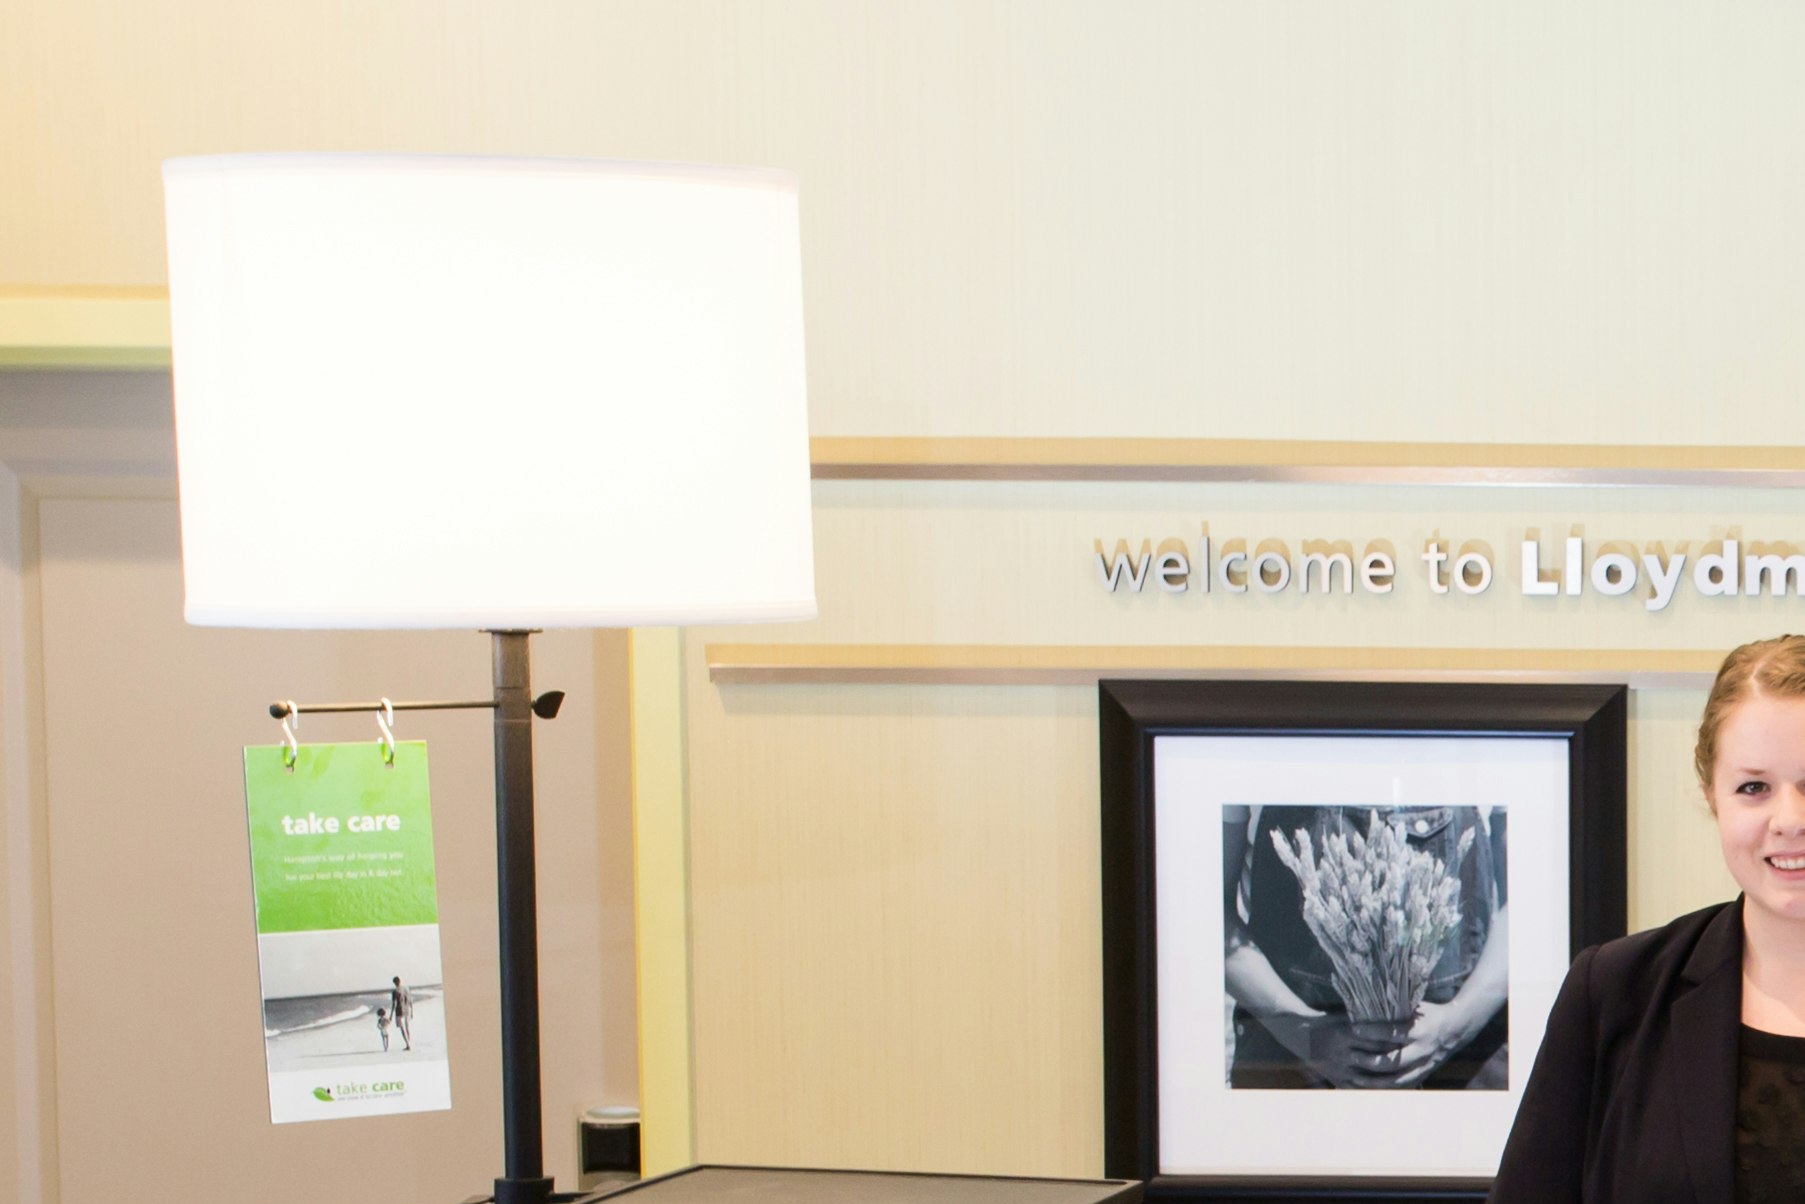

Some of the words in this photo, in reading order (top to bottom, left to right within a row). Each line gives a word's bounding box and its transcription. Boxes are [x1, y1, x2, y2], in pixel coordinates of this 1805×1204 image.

[1096, 536, 1396, 594] welcome
[1422, 543, 1494, 595] to
[281, 811, 340, 836] take
[347, 813, 401, 833] care
[336, 1081, 368, 1096] take
[371, 1080, 405, 1093] care
